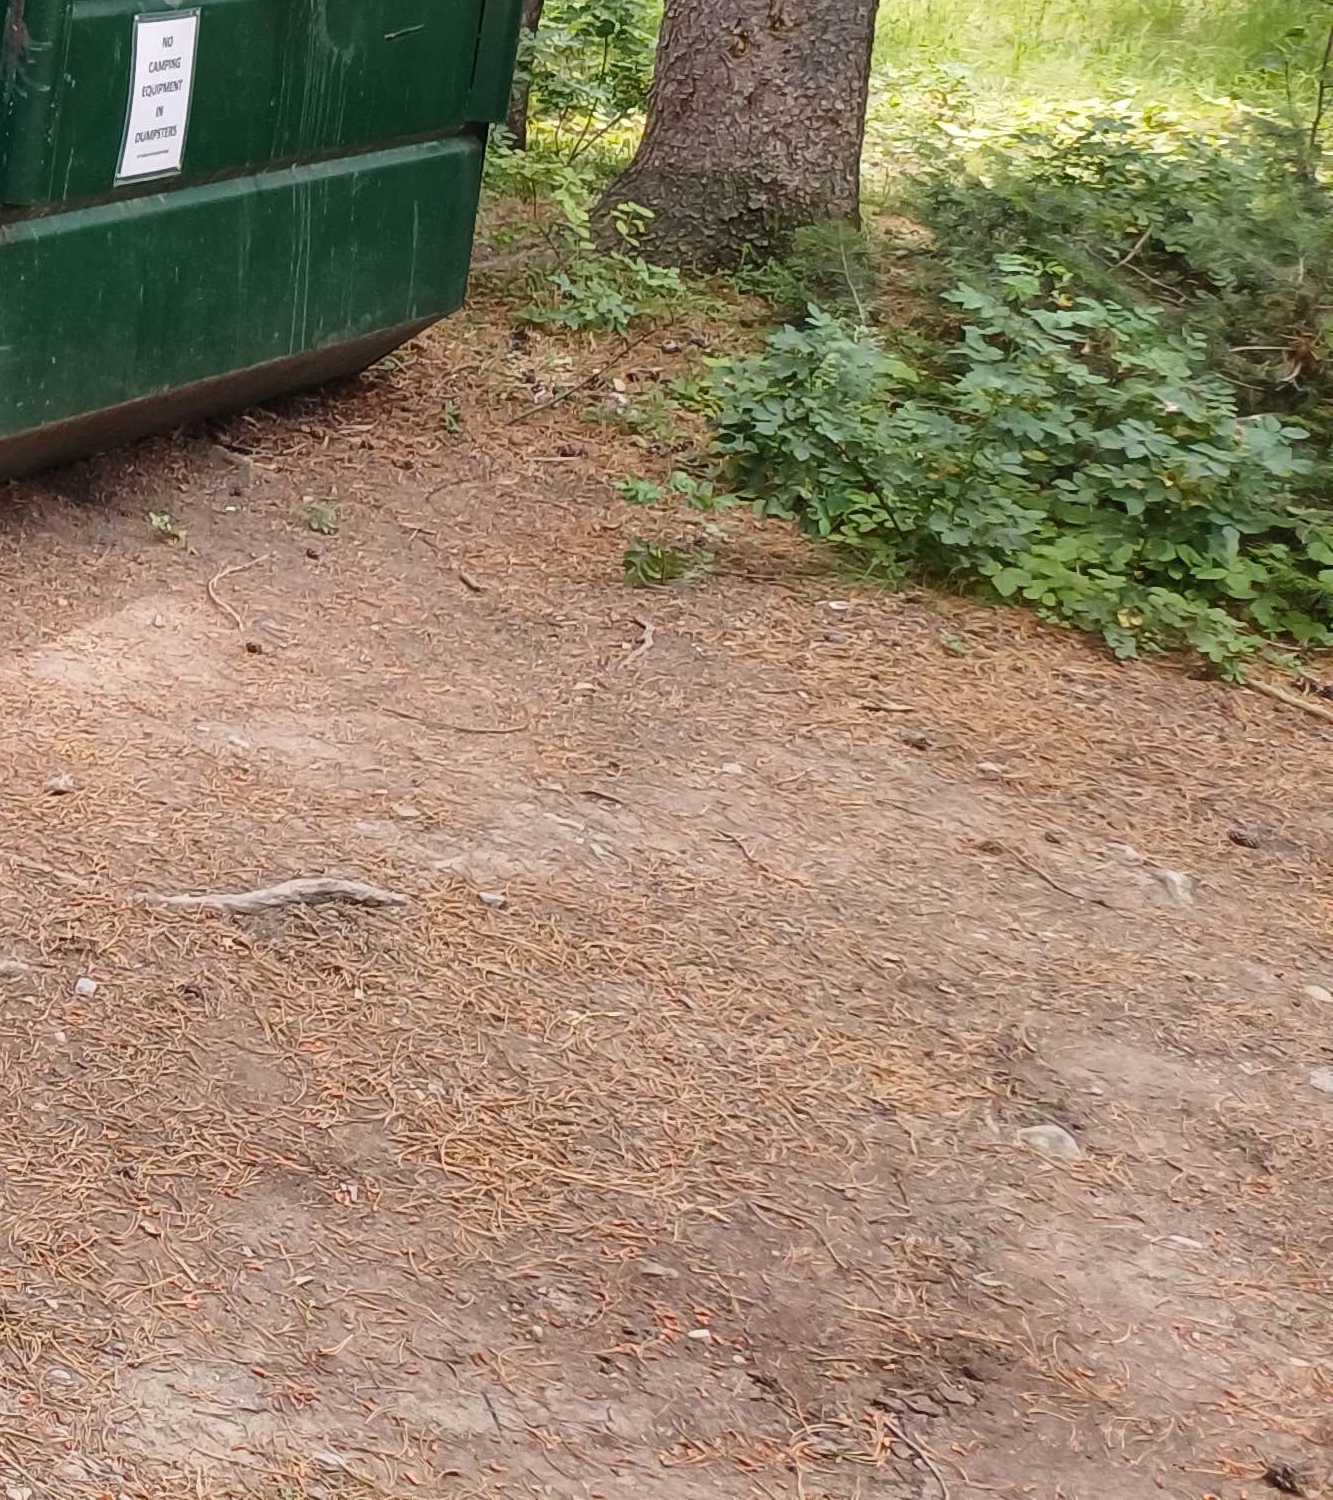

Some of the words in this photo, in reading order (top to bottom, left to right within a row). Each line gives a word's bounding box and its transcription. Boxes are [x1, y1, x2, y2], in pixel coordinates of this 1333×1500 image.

[162, 36, 174, 48] NO
[148, 57, 182, 74] CAMPING
[141, 79, 183, 98] EQUIPMENT
[155, 105, 164, 118] IN
[134, 125, 177, 144] DUMPSTERS
